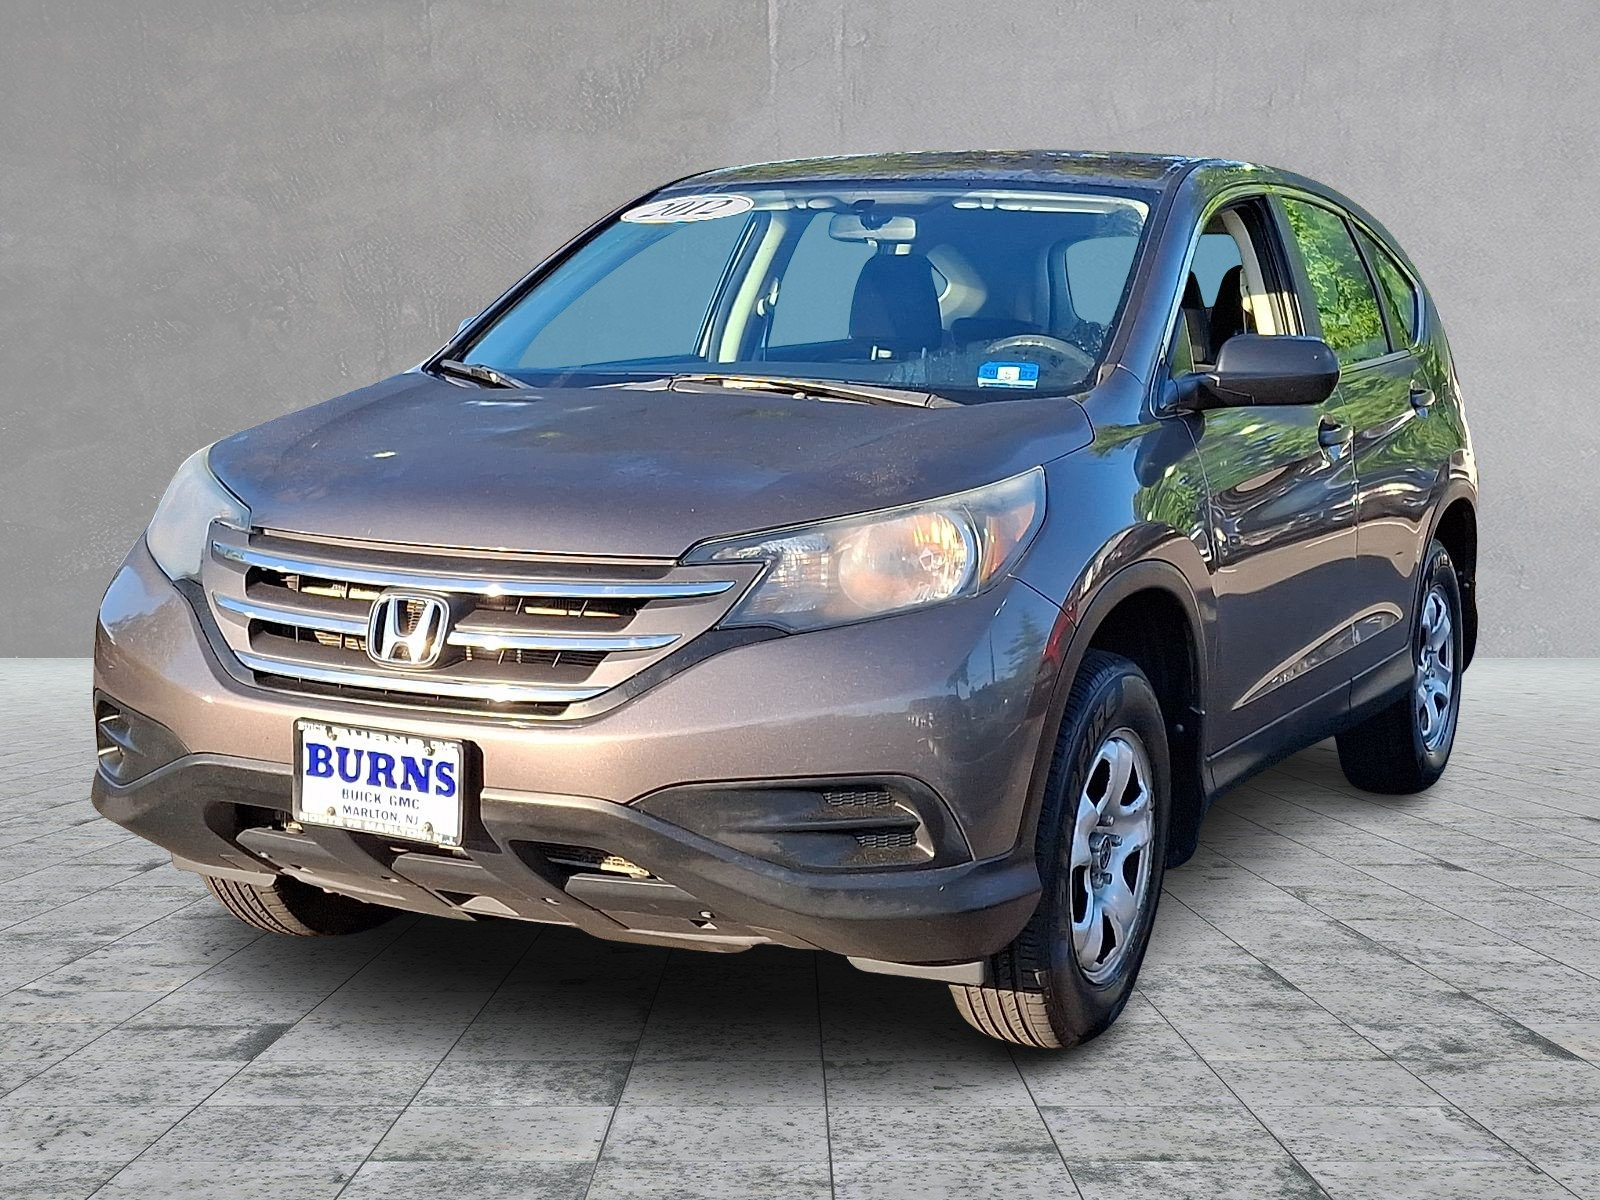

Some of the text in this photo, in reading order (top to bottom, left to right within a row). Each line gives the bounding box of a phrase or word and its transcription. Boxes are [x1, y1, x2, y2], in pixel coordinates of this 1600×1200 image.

[637, 199, 734, 218] 2012
[305, 742, 456, 798] BURNS
[341, 788, 420, 810] BUICK GMC
[342, 804, 419, 826] MARLTON, NJ
